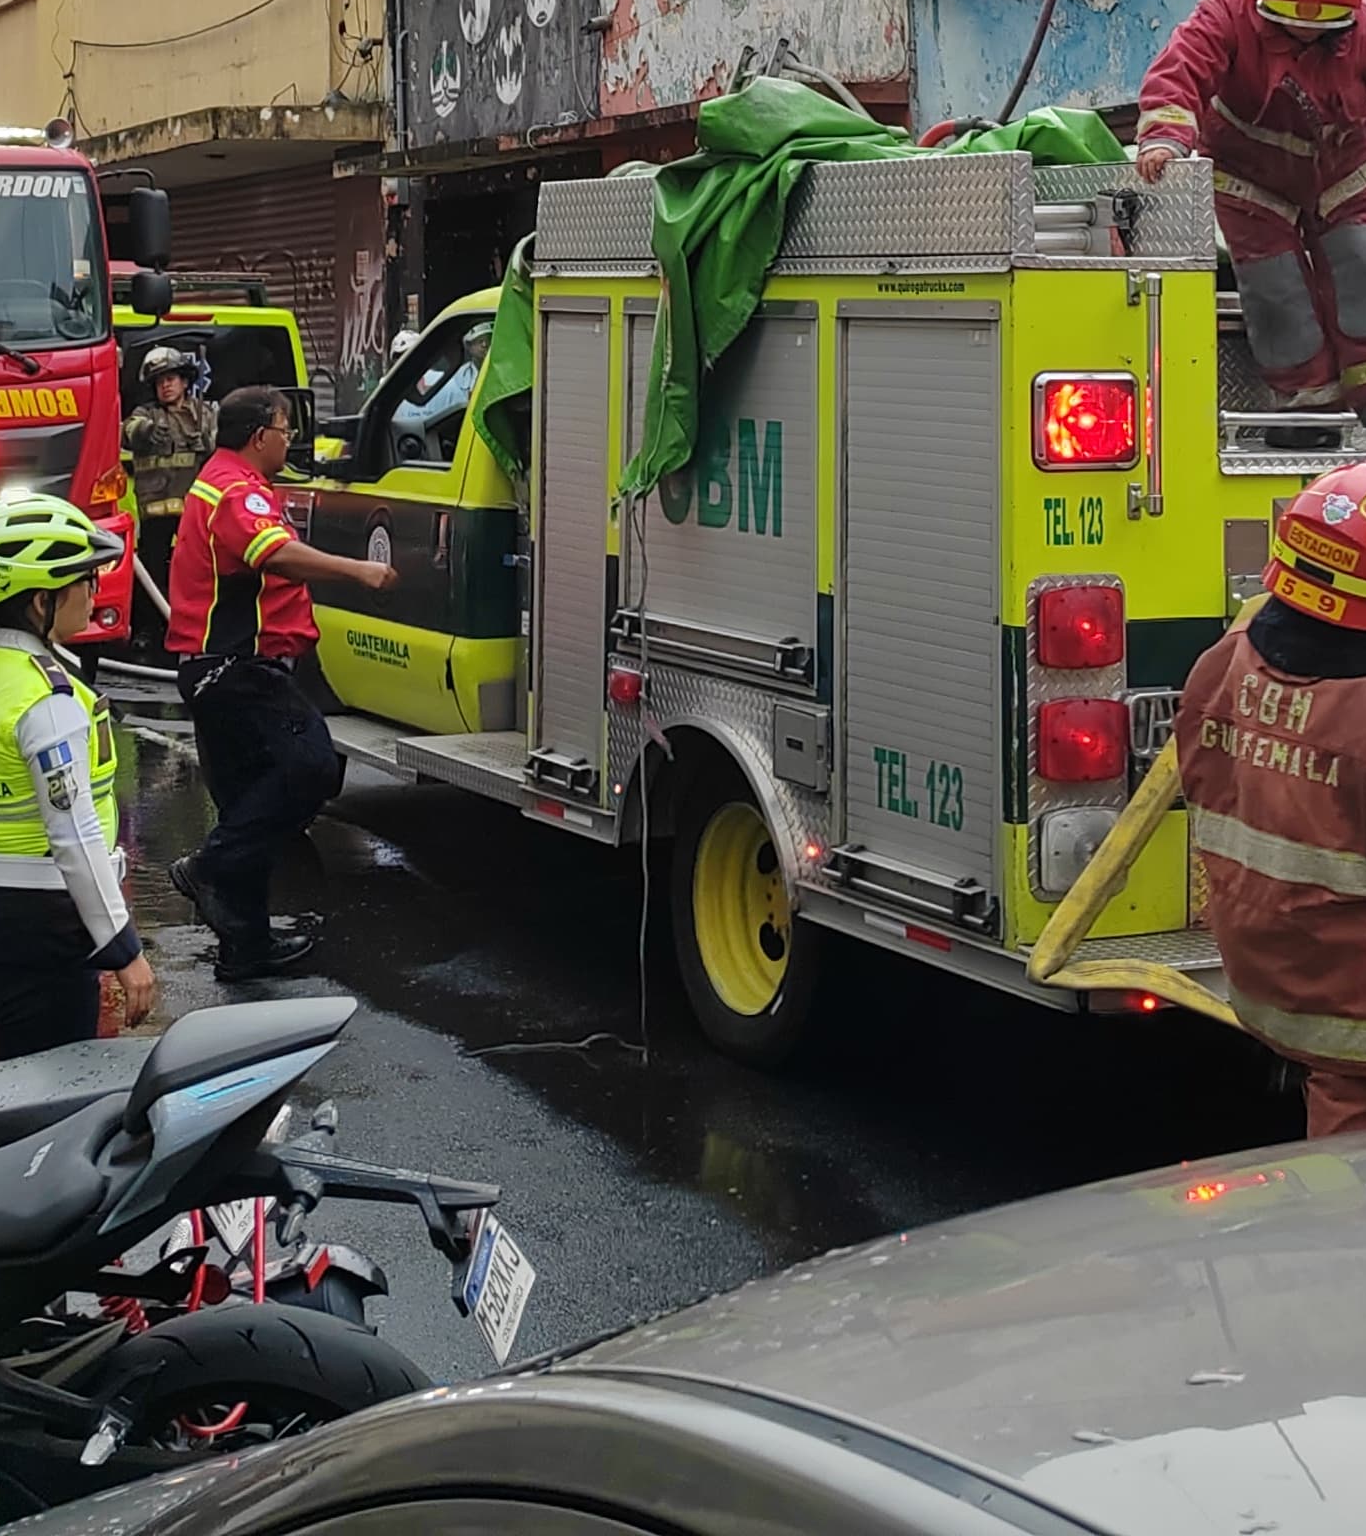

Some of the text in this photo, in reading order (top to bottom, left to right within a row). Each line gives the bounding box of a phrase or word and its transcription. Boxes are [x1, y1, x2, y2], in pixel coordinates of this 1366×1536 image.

[1043, 496, 1104, 546] TEL. 123
[1288, 526, 1356, 568] ESTACION
[346, 629, 411, 661] GUATEMALA
[1239, 673, 1314, 735] CBM
[873, 746, 964, 832] TEL. 123
[476, 1232, 521, 1346] M582KKJ
